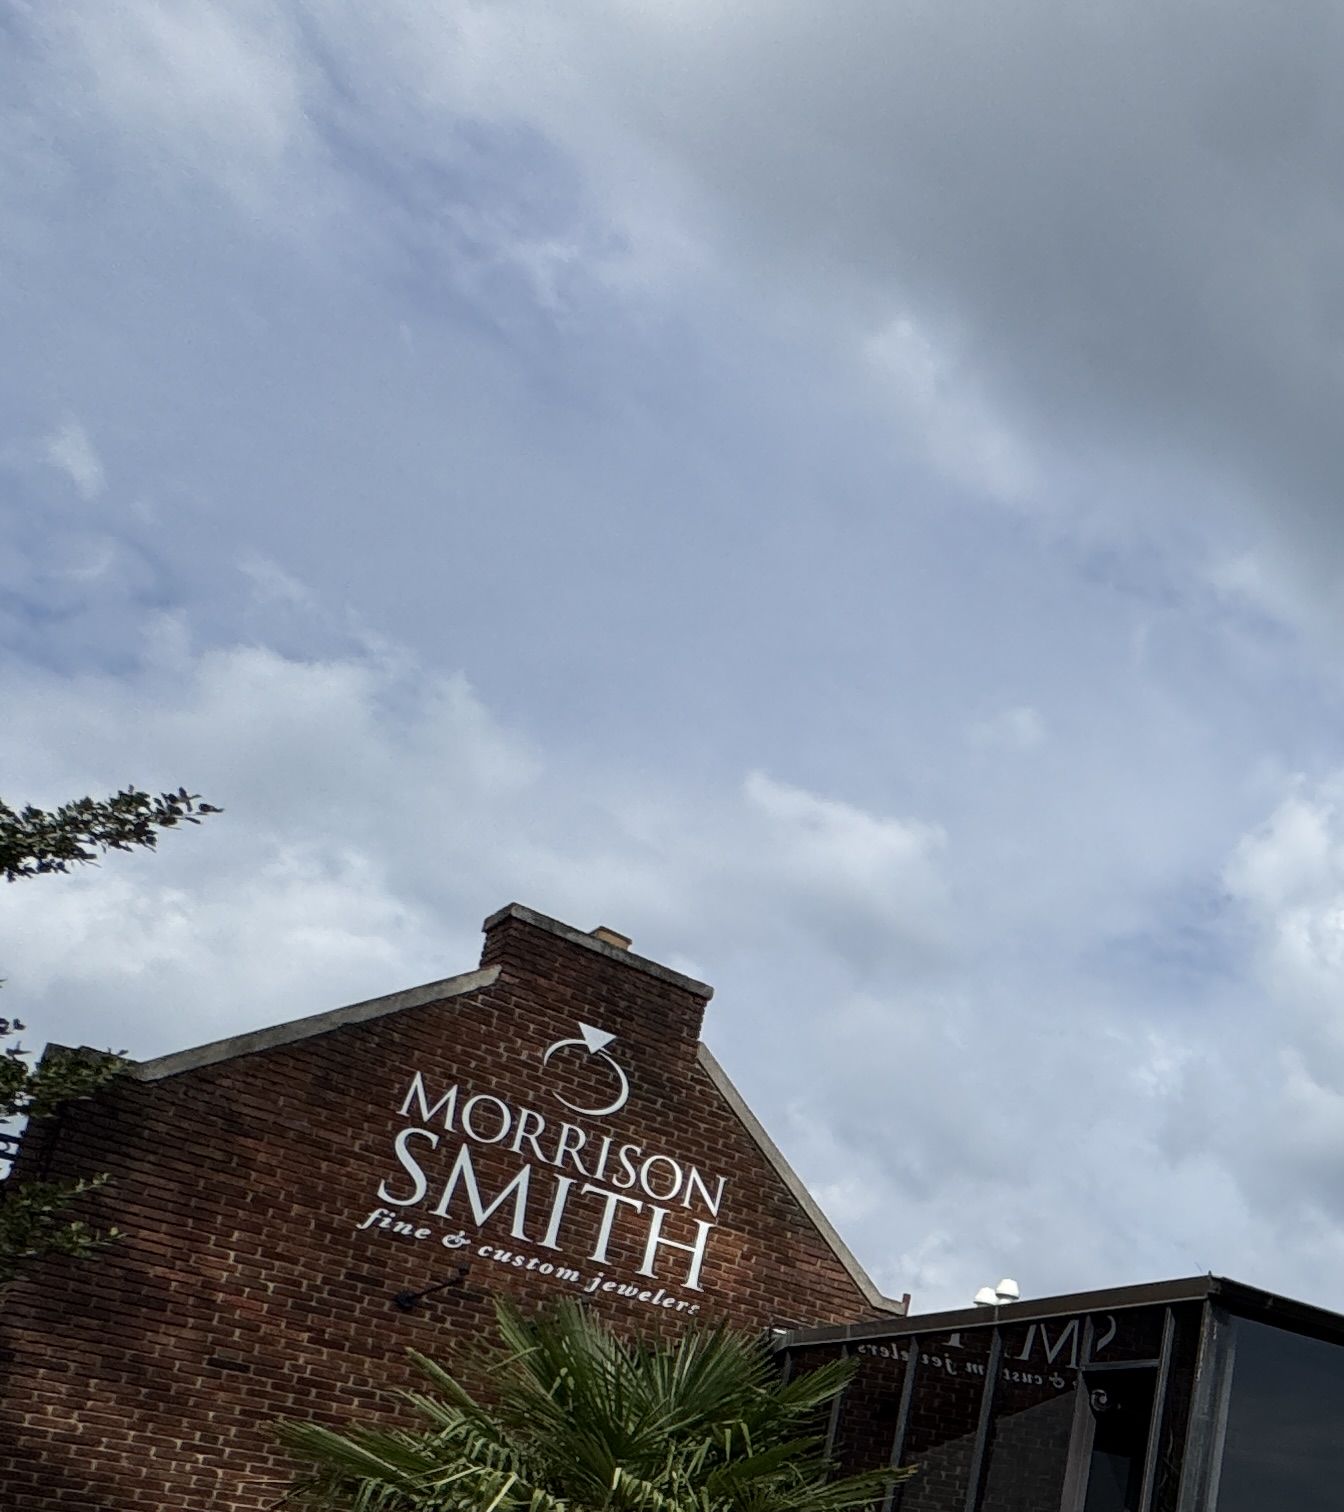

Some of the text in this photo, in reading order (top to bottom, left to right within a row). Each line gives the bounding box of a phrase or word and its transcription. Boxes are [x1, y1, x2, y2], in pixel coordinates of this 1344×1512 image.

[376, 1127, 718, 1293] SMITH
[397, 1070, 726, 1217] MORRISON
[356, 1208, 701, 1316] fine & custom jewelers
